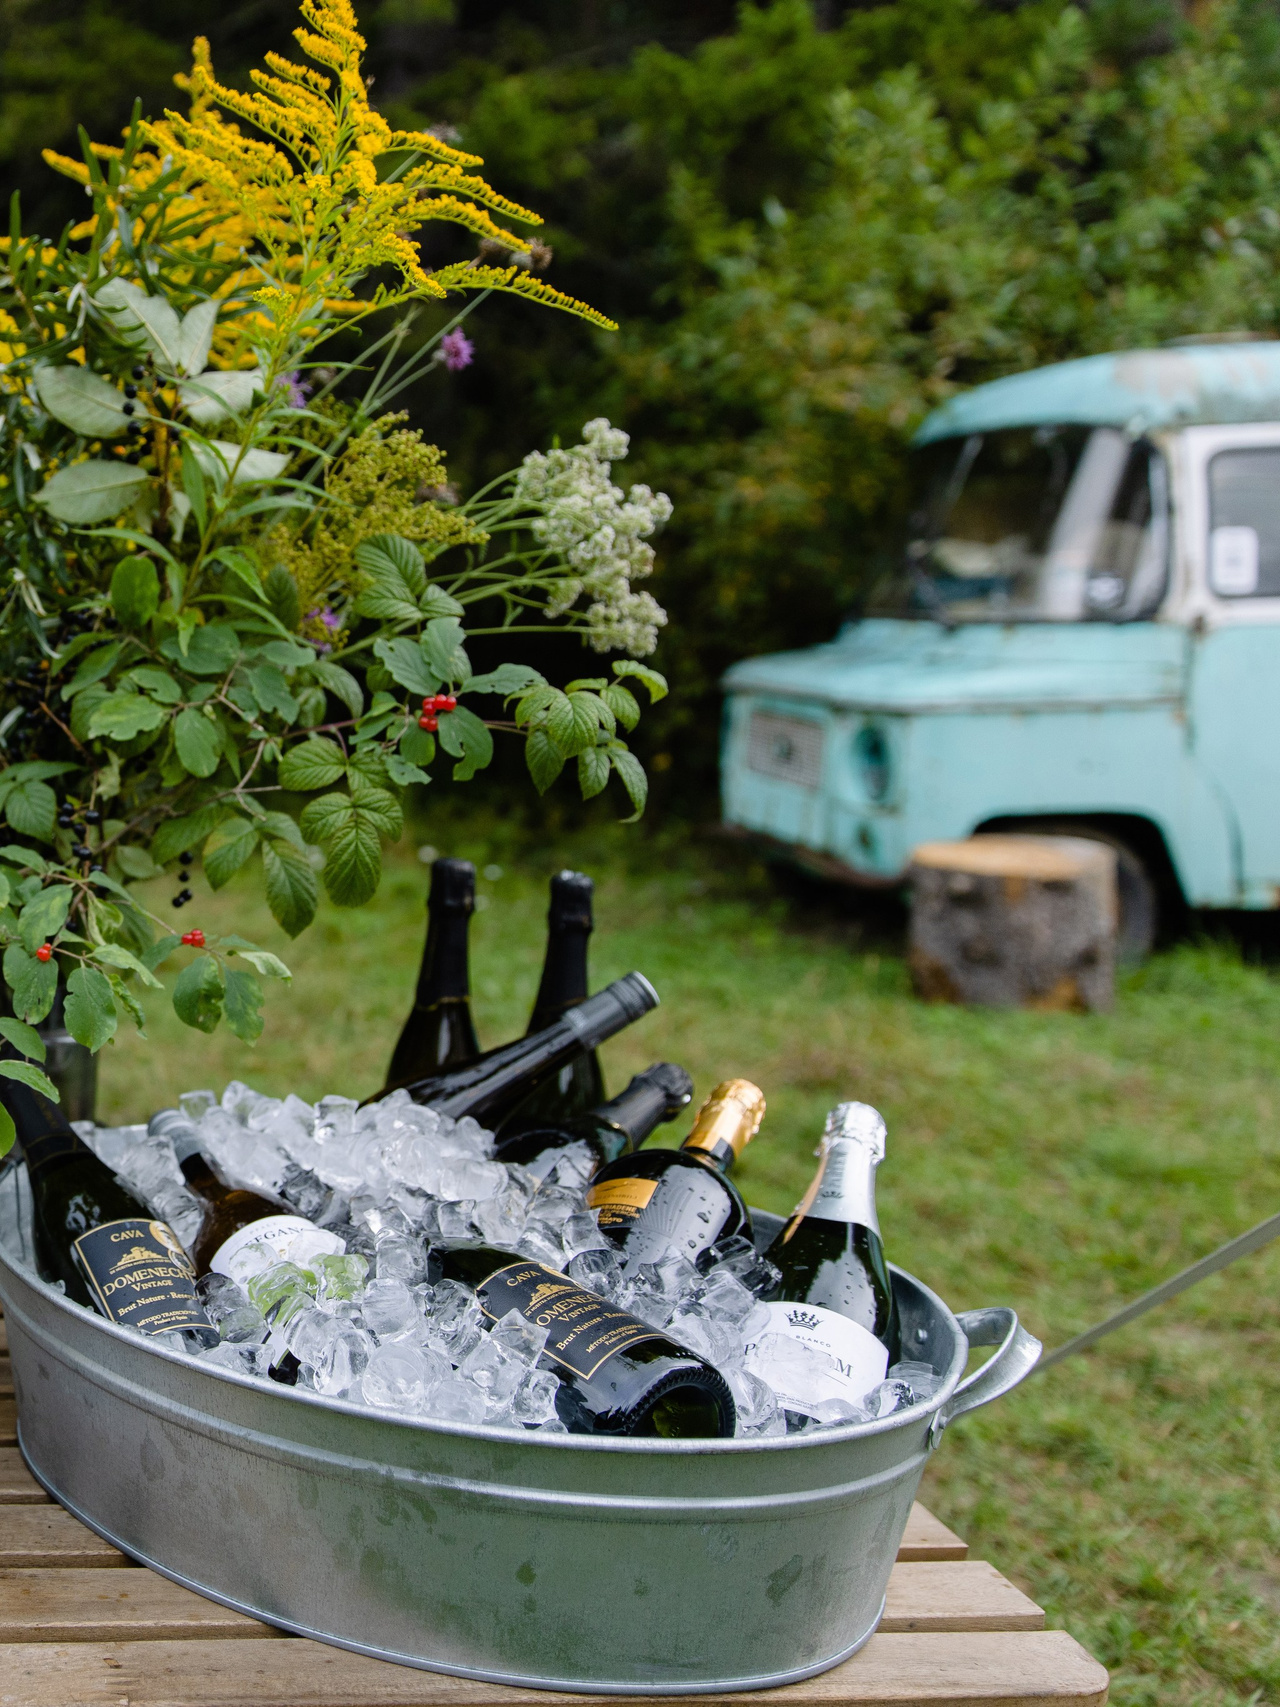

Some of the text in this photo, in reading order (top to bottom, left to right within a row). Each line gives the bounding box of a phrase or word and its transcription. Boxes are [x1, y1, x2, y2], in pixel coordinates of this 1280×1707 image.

[110, 1229, 145, 1243] CAVA
[103, 1267, 191, 1296] DOMENECH
[131, 1279, 174, 1292] VINTAGE
[506, 1269, 541, 1287] CAVA
[117, 1303, 137, 1317] Brut
[136, 1294, 166, 1307] Nature
[536, 1294, 603, 1327] OMENEC
[558, 1303, 601, 1322] VINTAGE
[556, 1331, 576, 1351] Brut
[573, 1316, 603, 1335] Nature
[795, 1335, 832, 1348] BLANCO
